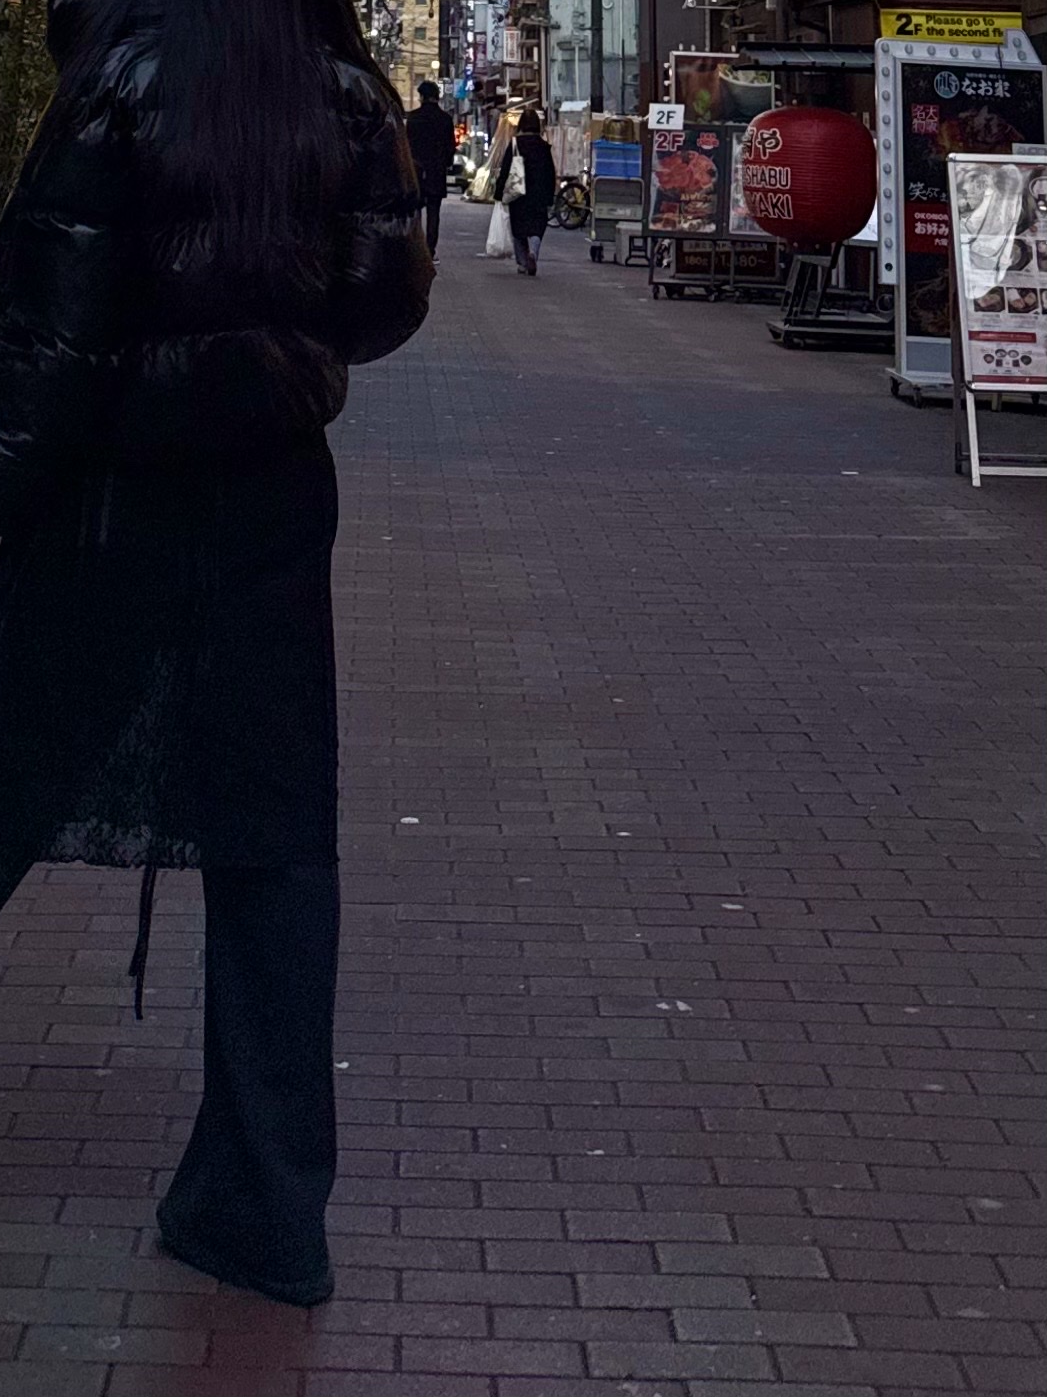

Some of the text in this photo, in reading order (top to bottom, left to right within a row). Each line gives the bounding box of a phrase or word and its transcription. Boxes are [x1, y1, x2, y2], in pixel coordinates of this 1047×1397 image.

[895, 13, 994, 36] 2F Please go to
[926, 26, 945, 36] the
[948, 27, 989, 37] second
[961, 77, 1012, 98] なお家
[656, 111, 676, 124] 2F
[655, 131, 685, 151] 2F
